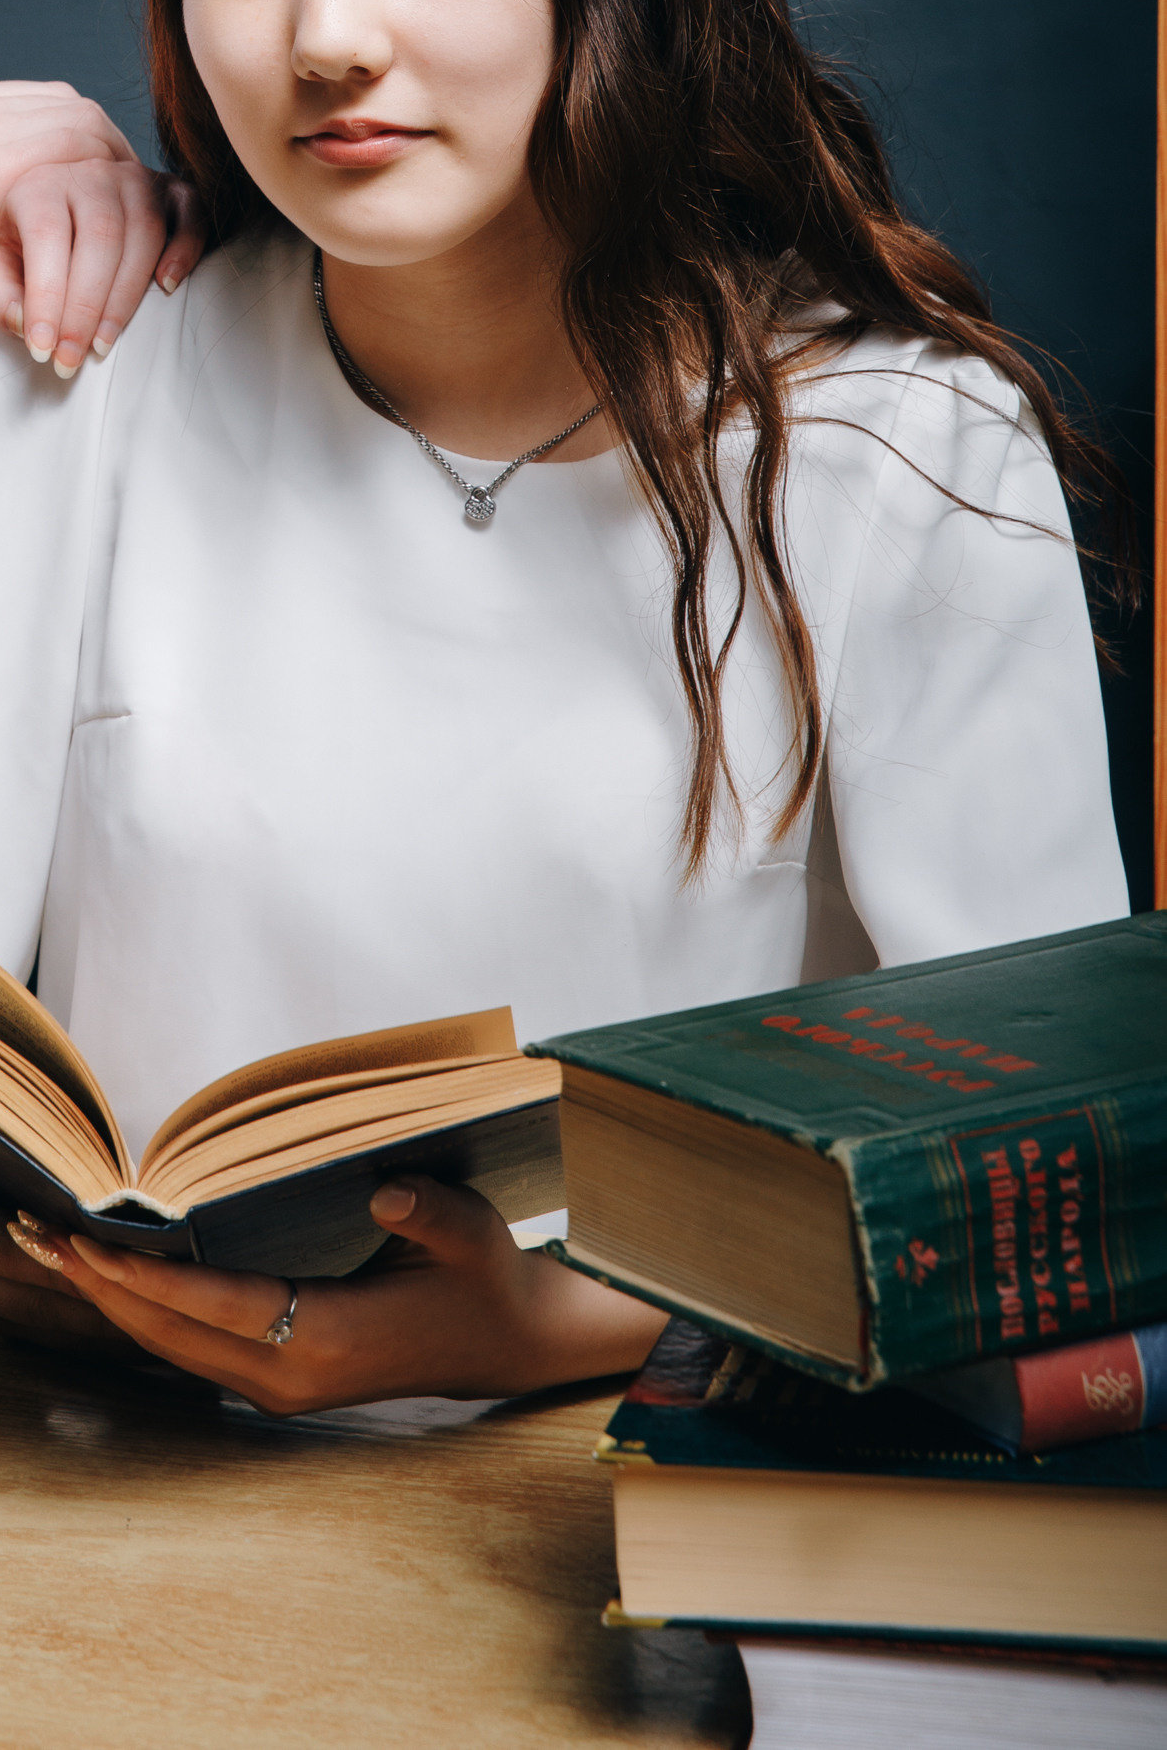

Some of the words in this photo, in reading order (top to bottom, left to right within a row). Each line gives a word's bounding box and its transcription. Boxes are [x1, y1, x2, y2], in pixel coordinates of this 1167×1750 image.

[981, 1144, 1026, 1340] ПОСЛОВИЦЫ
[1019, 1138, 1060, 1336] РУССКОГО
[1056, 1142, 1091, 1315] НАРОДА
